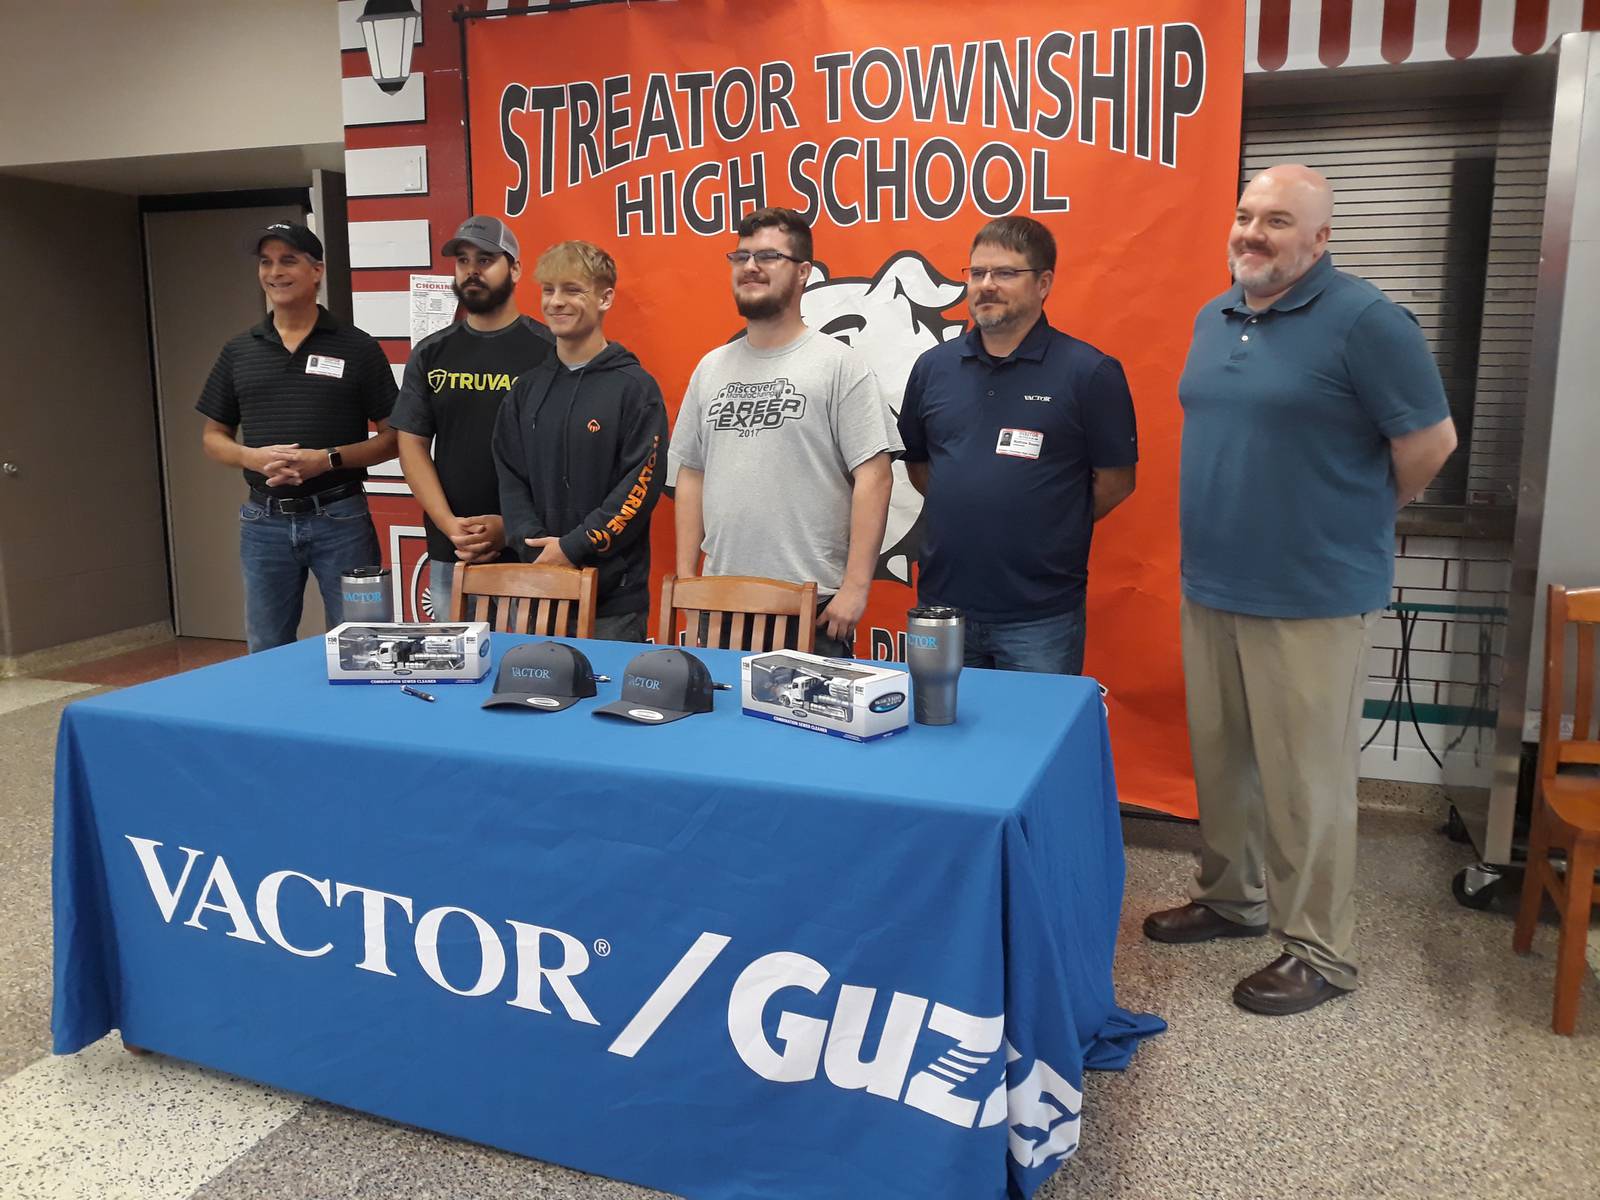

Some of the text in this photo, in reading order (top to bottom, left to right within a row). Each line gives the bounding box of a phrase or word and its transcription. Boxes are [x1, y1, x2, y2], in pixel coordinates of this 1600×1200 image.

[500, 22, 1206, 218] STREATOR TOWNSHIP
[616, 136, 1070, 237] HIGH SCHOOL
[447, 372, 519, 391] TRUVA
[727, 383, 776, 394] Discover
[708, 399, 801, 417] CAREER
[717, 412, 782, 428] EXPO
[738, 428, 761, 438] 2017
[511, 666, 551, 679] VACTOR
